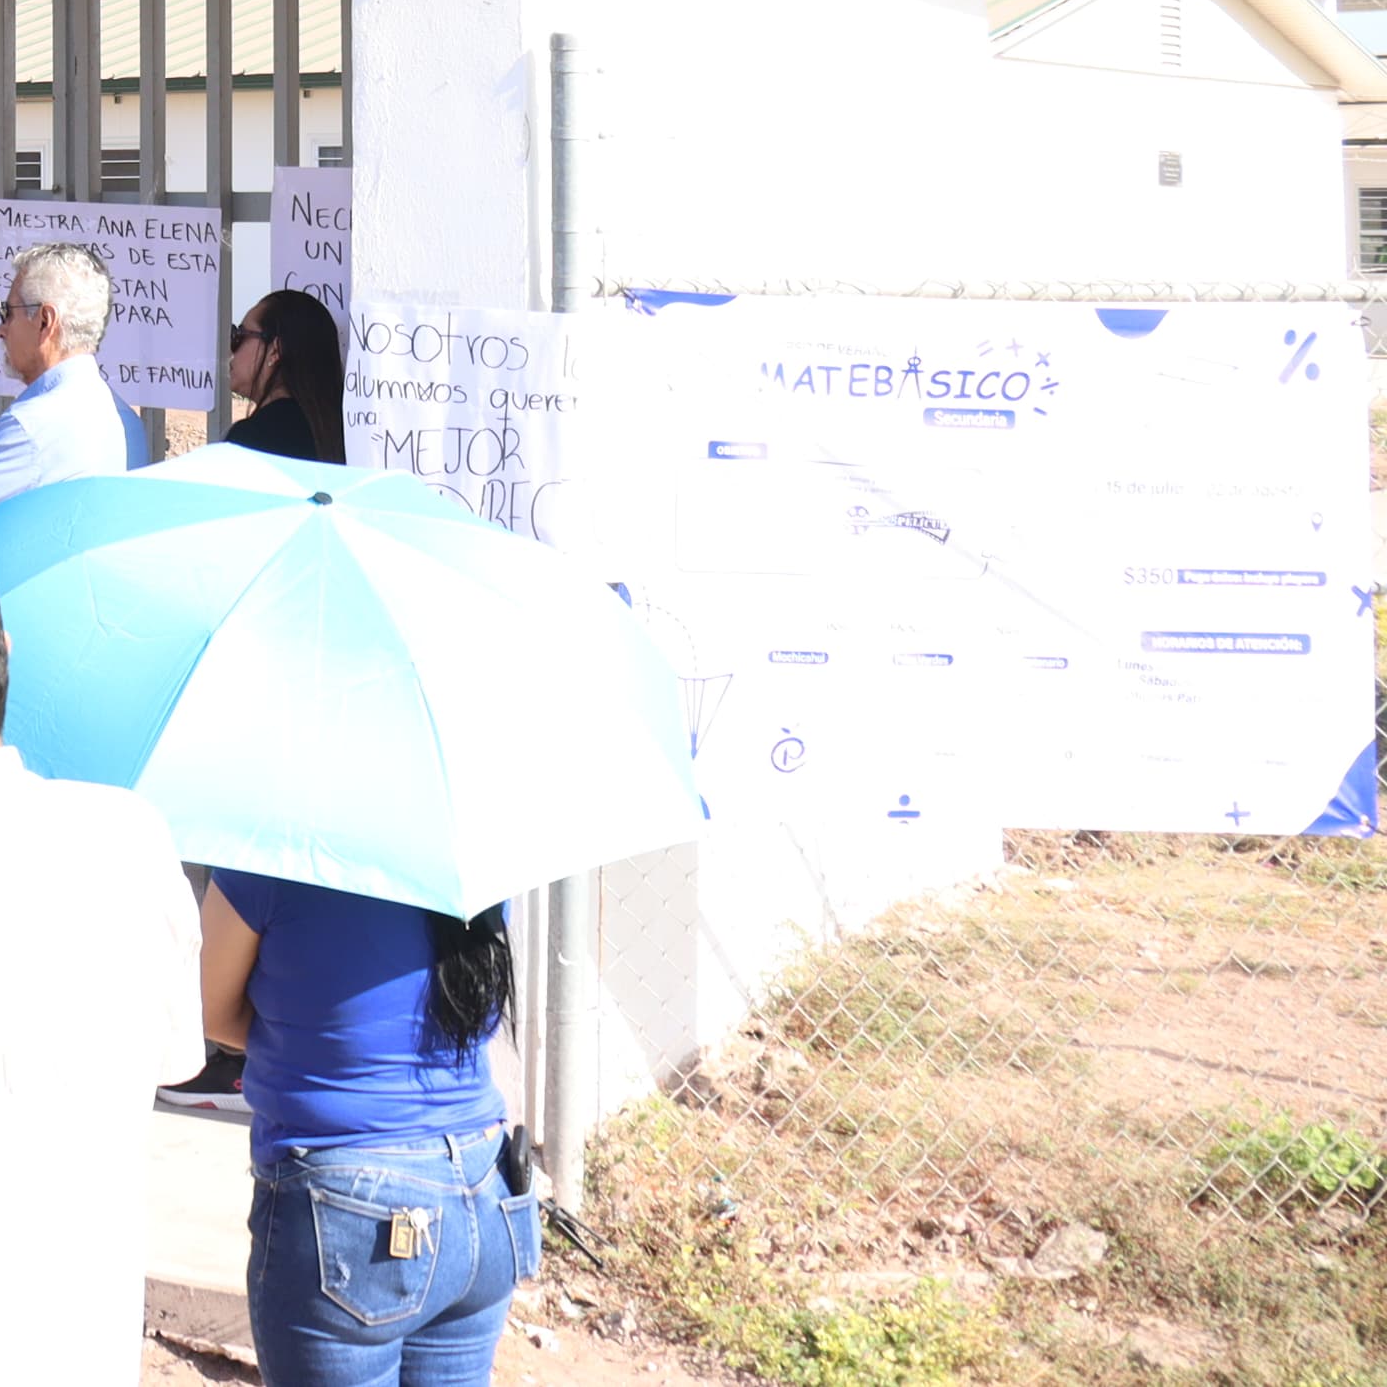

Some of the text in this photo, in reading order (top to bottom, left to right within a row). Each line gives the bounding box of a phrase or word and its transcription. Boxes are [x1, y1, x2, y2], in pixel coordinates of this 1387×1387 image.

[97, 216, 137, 238] ANA
[145, 218, 217, 243] ELENA
[129, 247, 155, 265] DE
[167, 253, 217, 273] ESTA
[305, 239, 342, 265] UN
[112, 303, 173, 328] PARA
[120, 364, 140, 383] DE
[933, 410, 1008, 429] Secundaria
